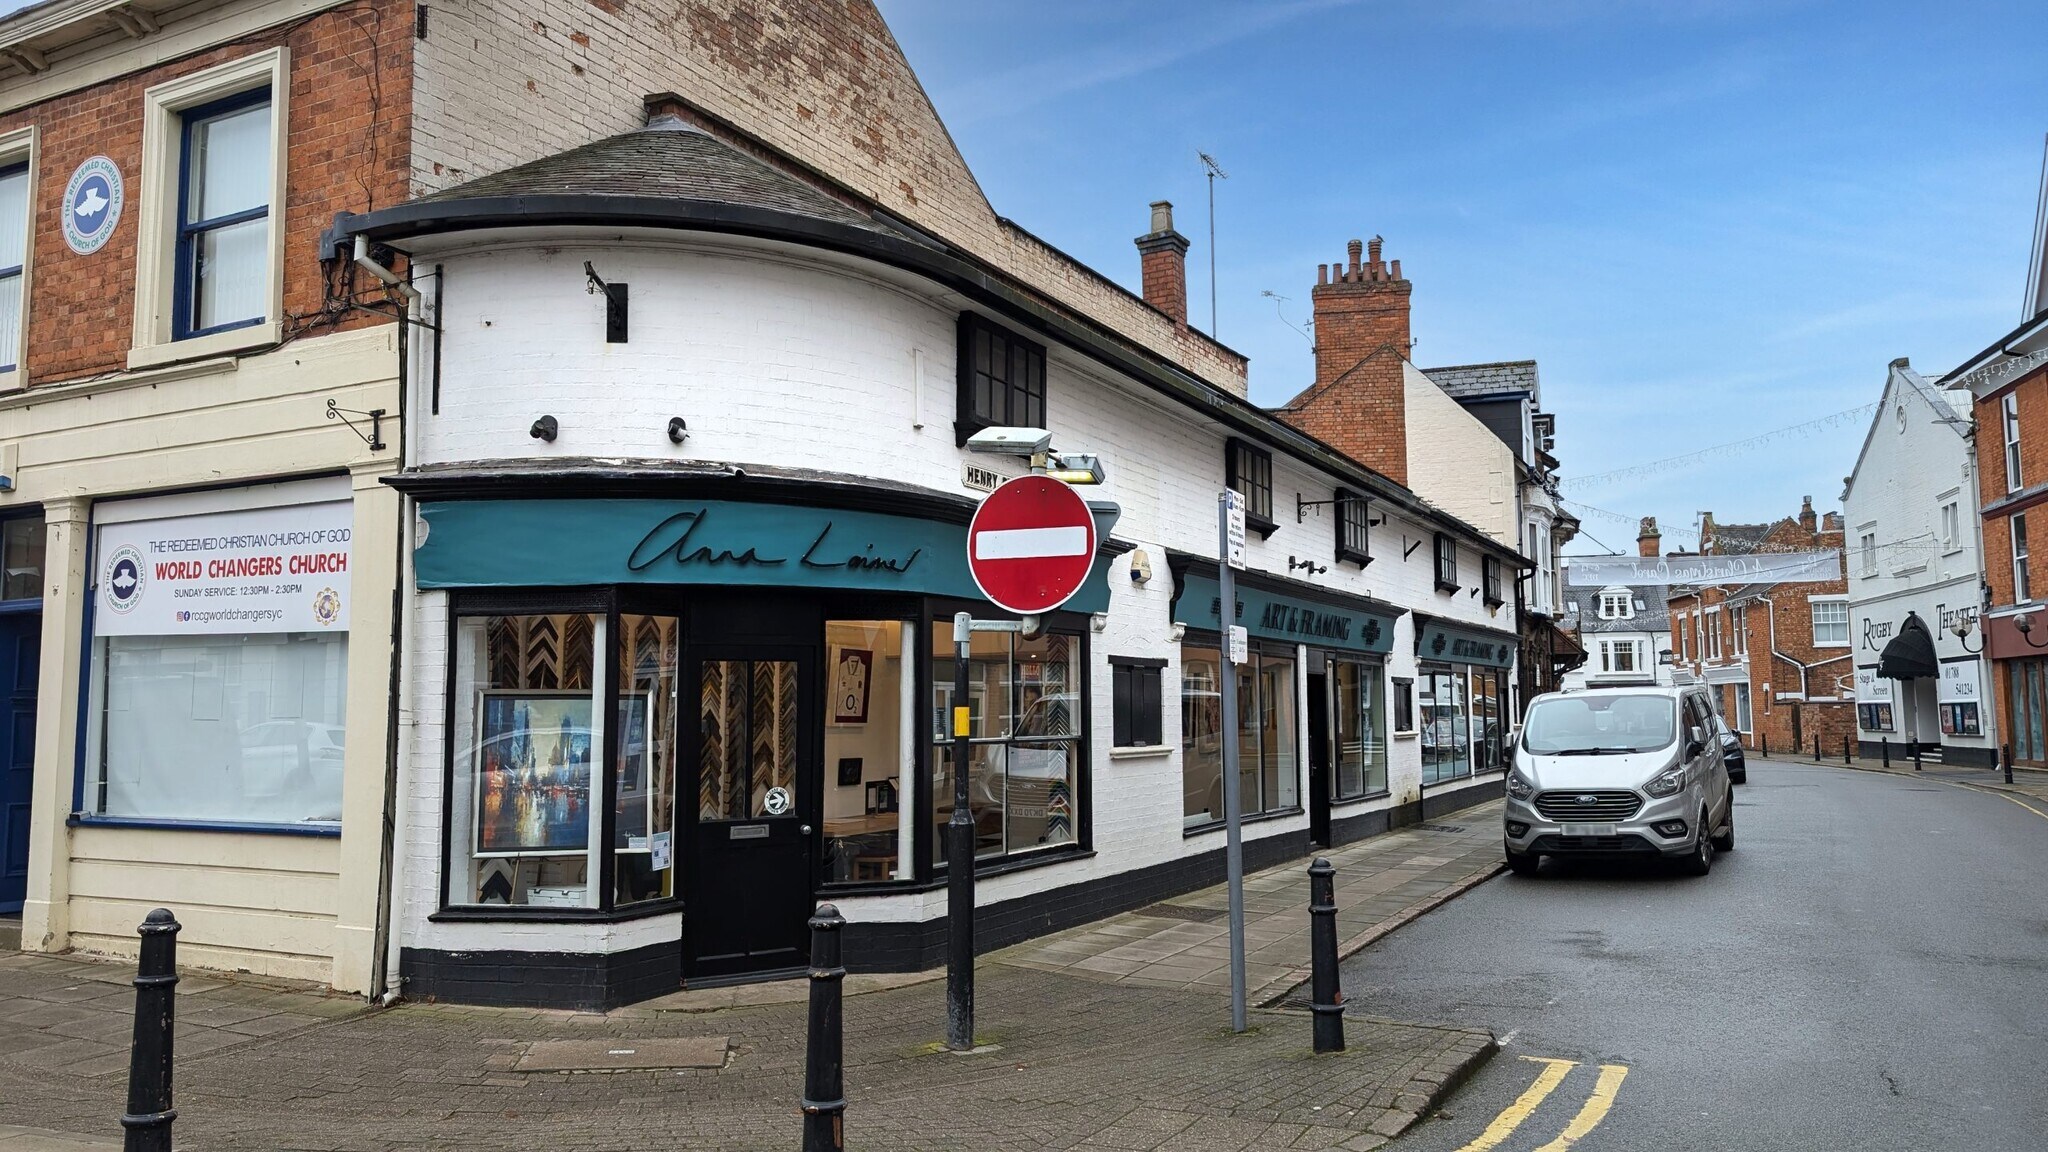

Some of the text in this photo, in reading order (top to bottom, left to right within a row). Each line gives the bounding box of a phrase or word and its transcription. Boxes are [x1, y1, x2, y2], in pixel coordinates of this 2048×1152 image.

[64, 161, 120, 218] THE REDEEMED CHRISTIAN
[68, 220, 113, 249] CHURCH OF GOD
[967, 466, 999, 488] HENRY
[149, 528, 351, 553] THE REDEEMED CHRISTIAN CHURCH OF GOD
[108, 548, 131, 571] REDEEMED
[131, 550, 144, 584] CHRISTIAN
[155, 552, 348, 581] WORLD CHANGERS CHURCH
[107, 592, 140, 610] CHURCH OF GOD
[174, 588, 203, 599] SUNDAY
[204, 586, 238, 598] SERVICE:
[240, 585, 269, 596] 12:30PM
[275, 584, 303, 595] 2:30PM
[191, 608, 283, 623] rccgworldchangersyc
[1260, 602, 1352, 641] ART & FRAMING
[1862, 617, 1893, 651] RUGBY
[1955, 682, 1973, 696] 541234
